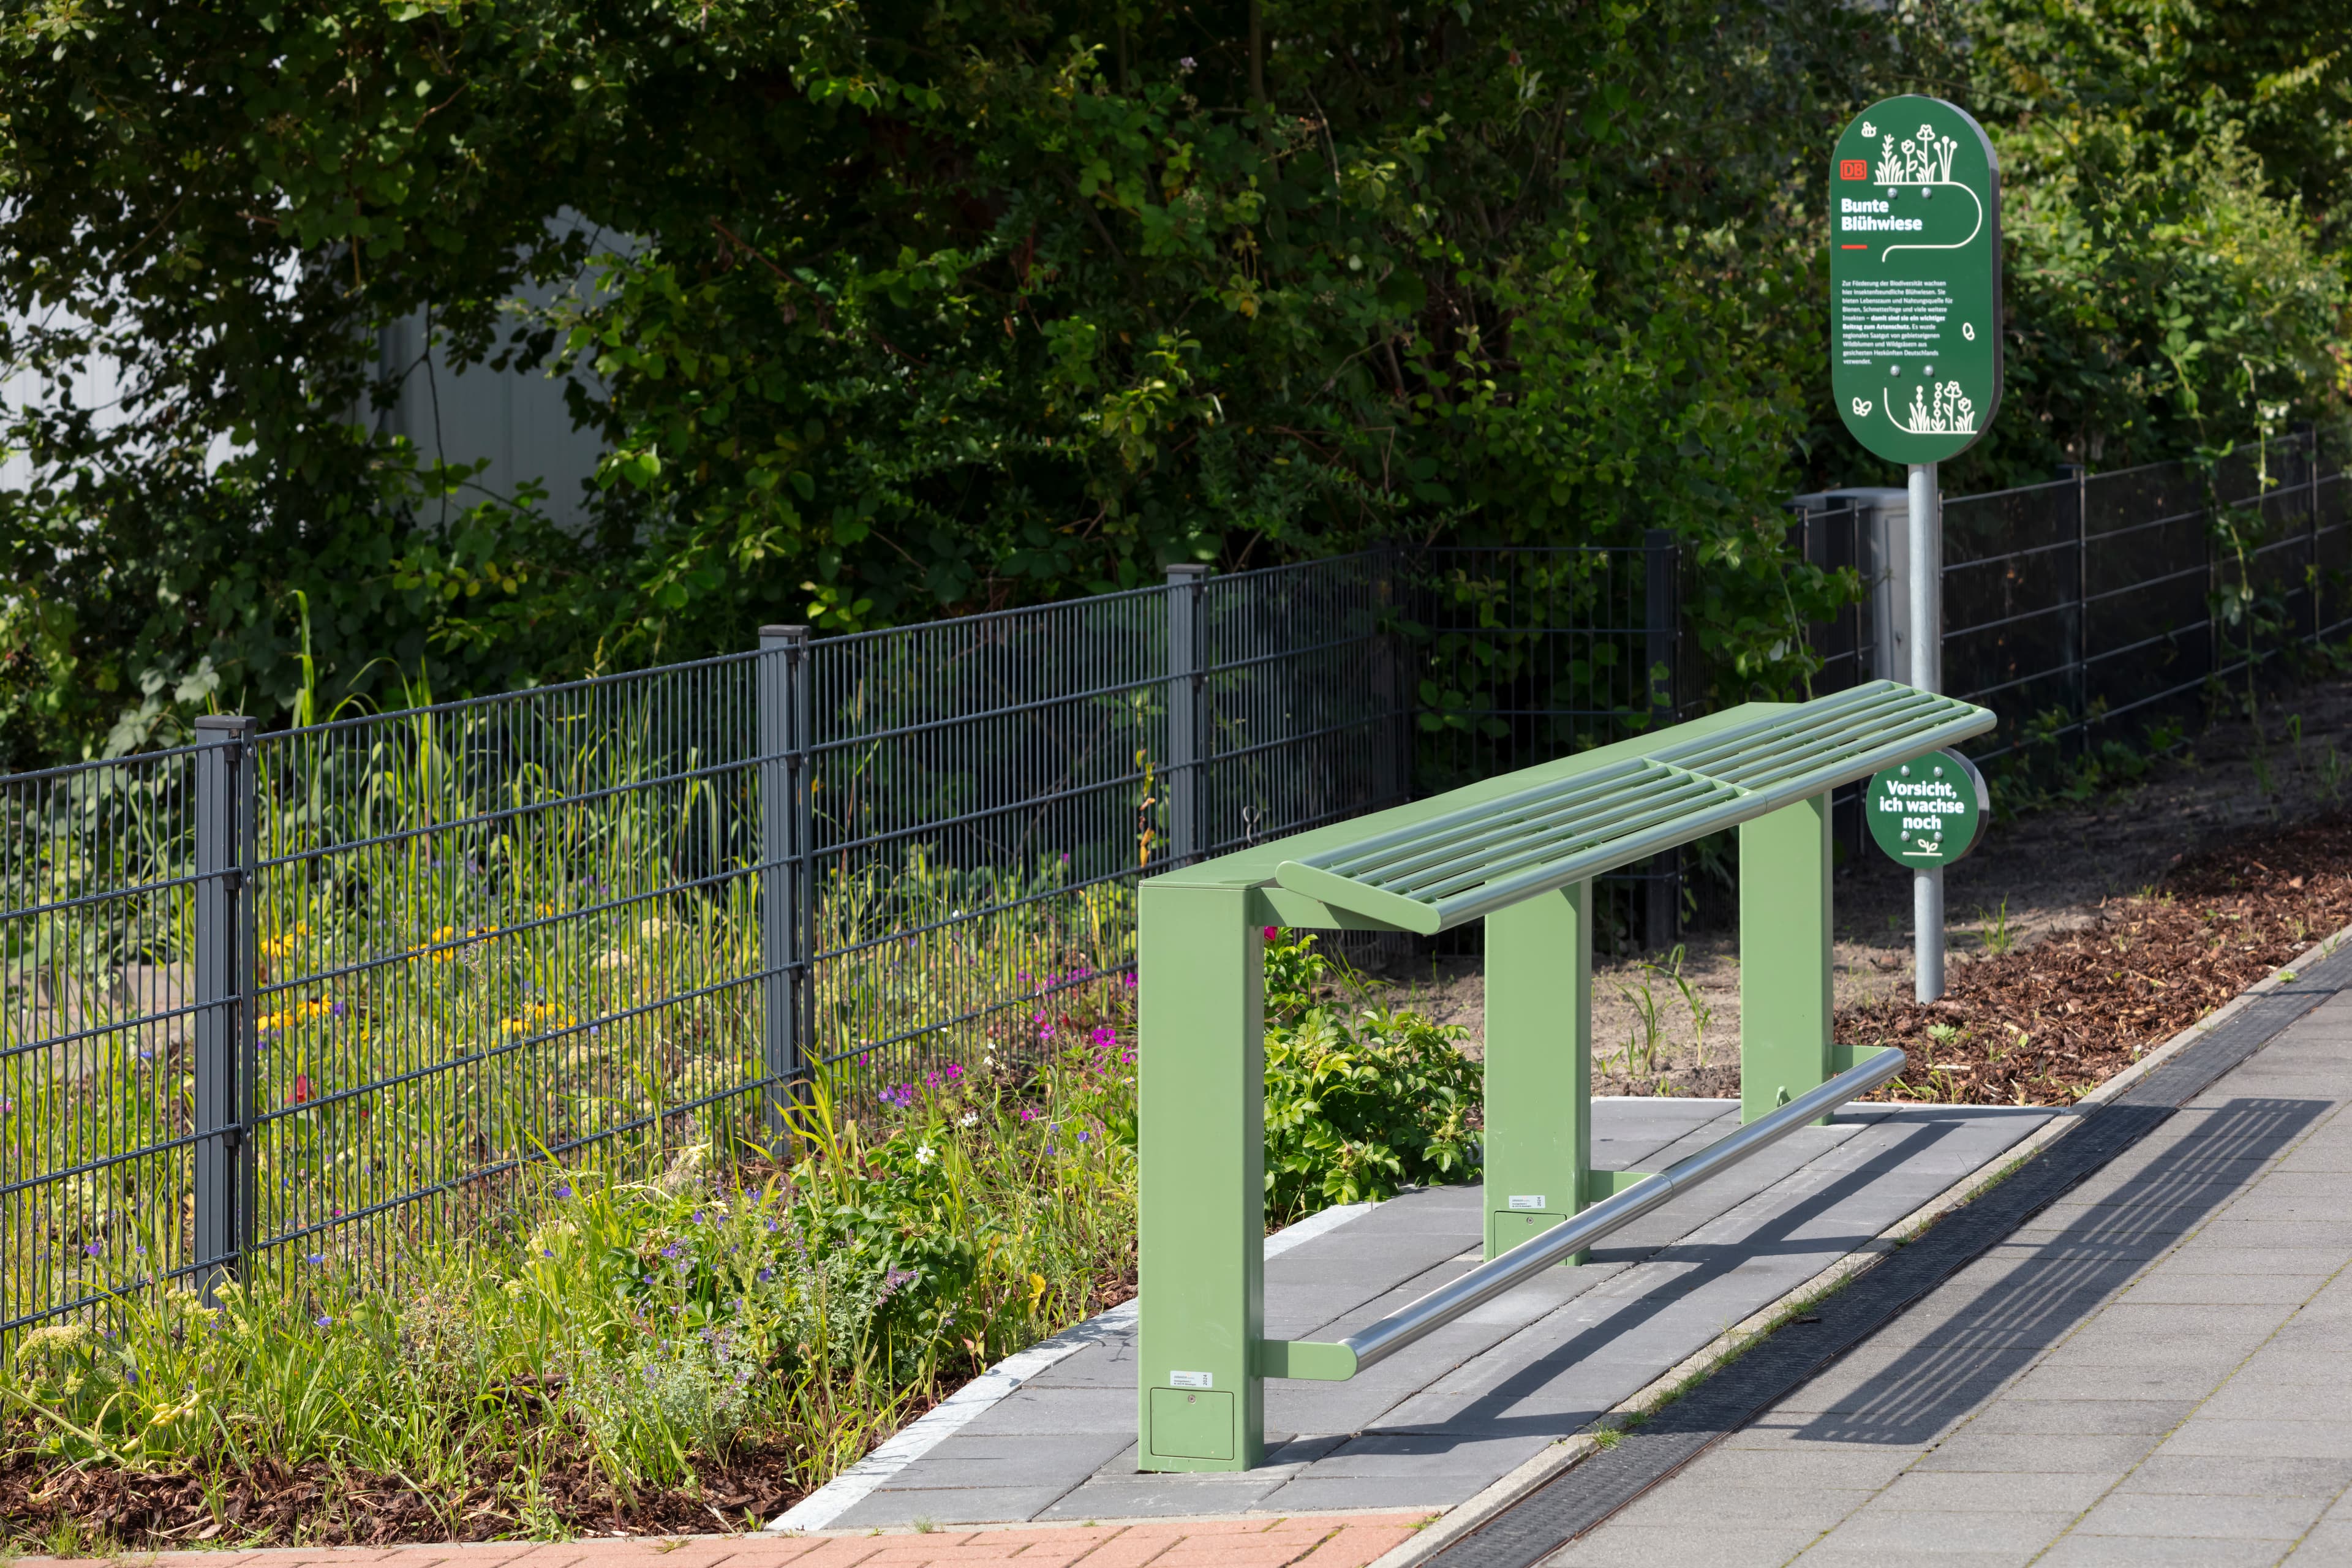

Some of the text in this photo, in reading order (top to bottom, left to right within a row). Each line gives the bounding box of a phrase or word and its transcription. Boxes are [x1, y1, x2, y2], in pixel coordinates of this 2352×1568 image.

[1843, 162, 1864, 178] DB
[1841, 198, 1890, 213] Bunte
[1841, 216, 1923, 231] Blühwiese
[1887, 780, 1957, 799] Vorsicht,
[1879, 796, 1964, 813] ich wachse
[1903, 815, 1942, 829] noch
